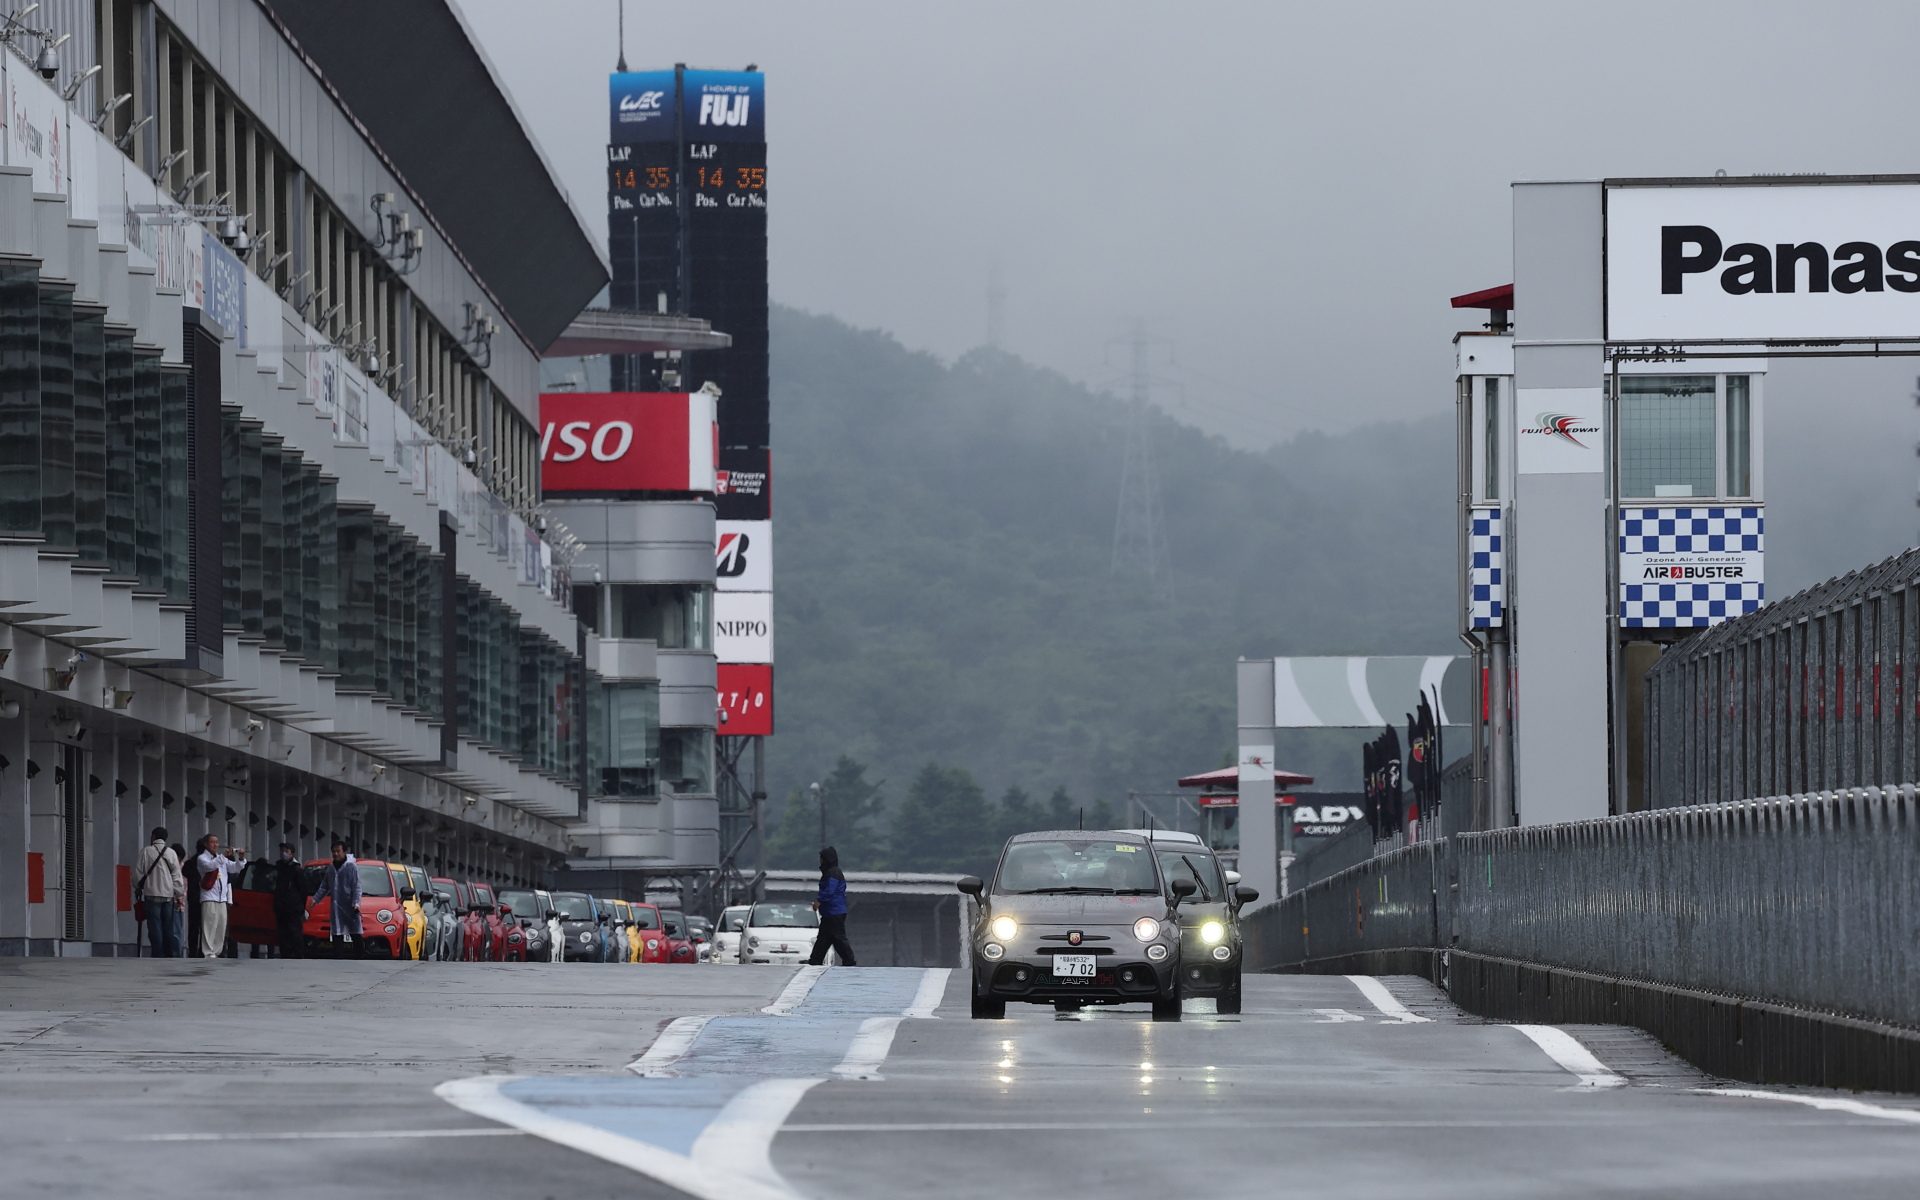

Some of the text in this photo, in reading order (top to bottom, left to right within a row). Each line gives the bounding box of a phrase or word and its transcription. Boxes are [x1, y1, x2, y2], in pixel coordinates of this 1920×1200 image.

[619, 91, 664, 110] WEC
[700, 94, 750, 126] FUJI
[610, 147, 631, 161] LAP
[690, 144, 717, 158] LAP
[615, 167, 670, 189] 14 35
[698, 167, 765, 188] 14 35
[614, 195, 633, 209] Pos.
[639, 193, 656, 207] Car
[695, 193, 766, 207] Pos. Car No.
[1661, 225, 1920, 295] Panas
[1643, 567, 1743, 578] AIR BUSTER
[717, 621, 767, 637] NIPPO
